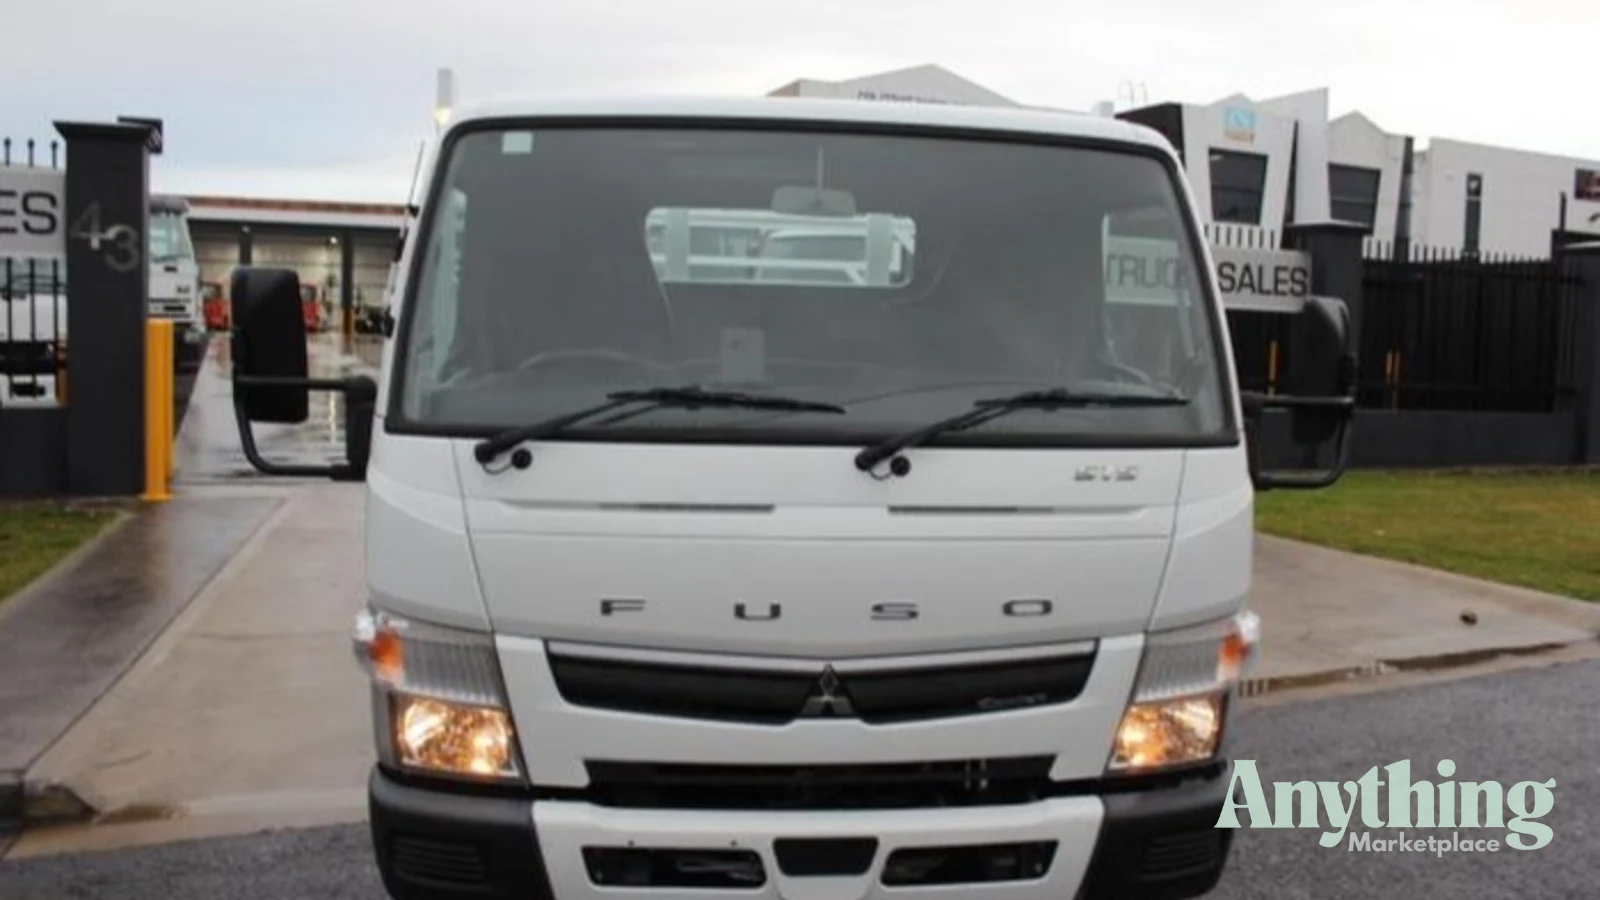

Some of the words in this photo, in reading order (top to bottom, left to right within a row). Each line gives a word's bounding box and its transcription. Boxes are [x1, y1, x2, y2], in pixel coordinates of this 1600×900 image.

[70, 199, 140, 272] 43
[1216, 260, 1310, 298] SALES
[600, 598, 1053, 622] FUSO
